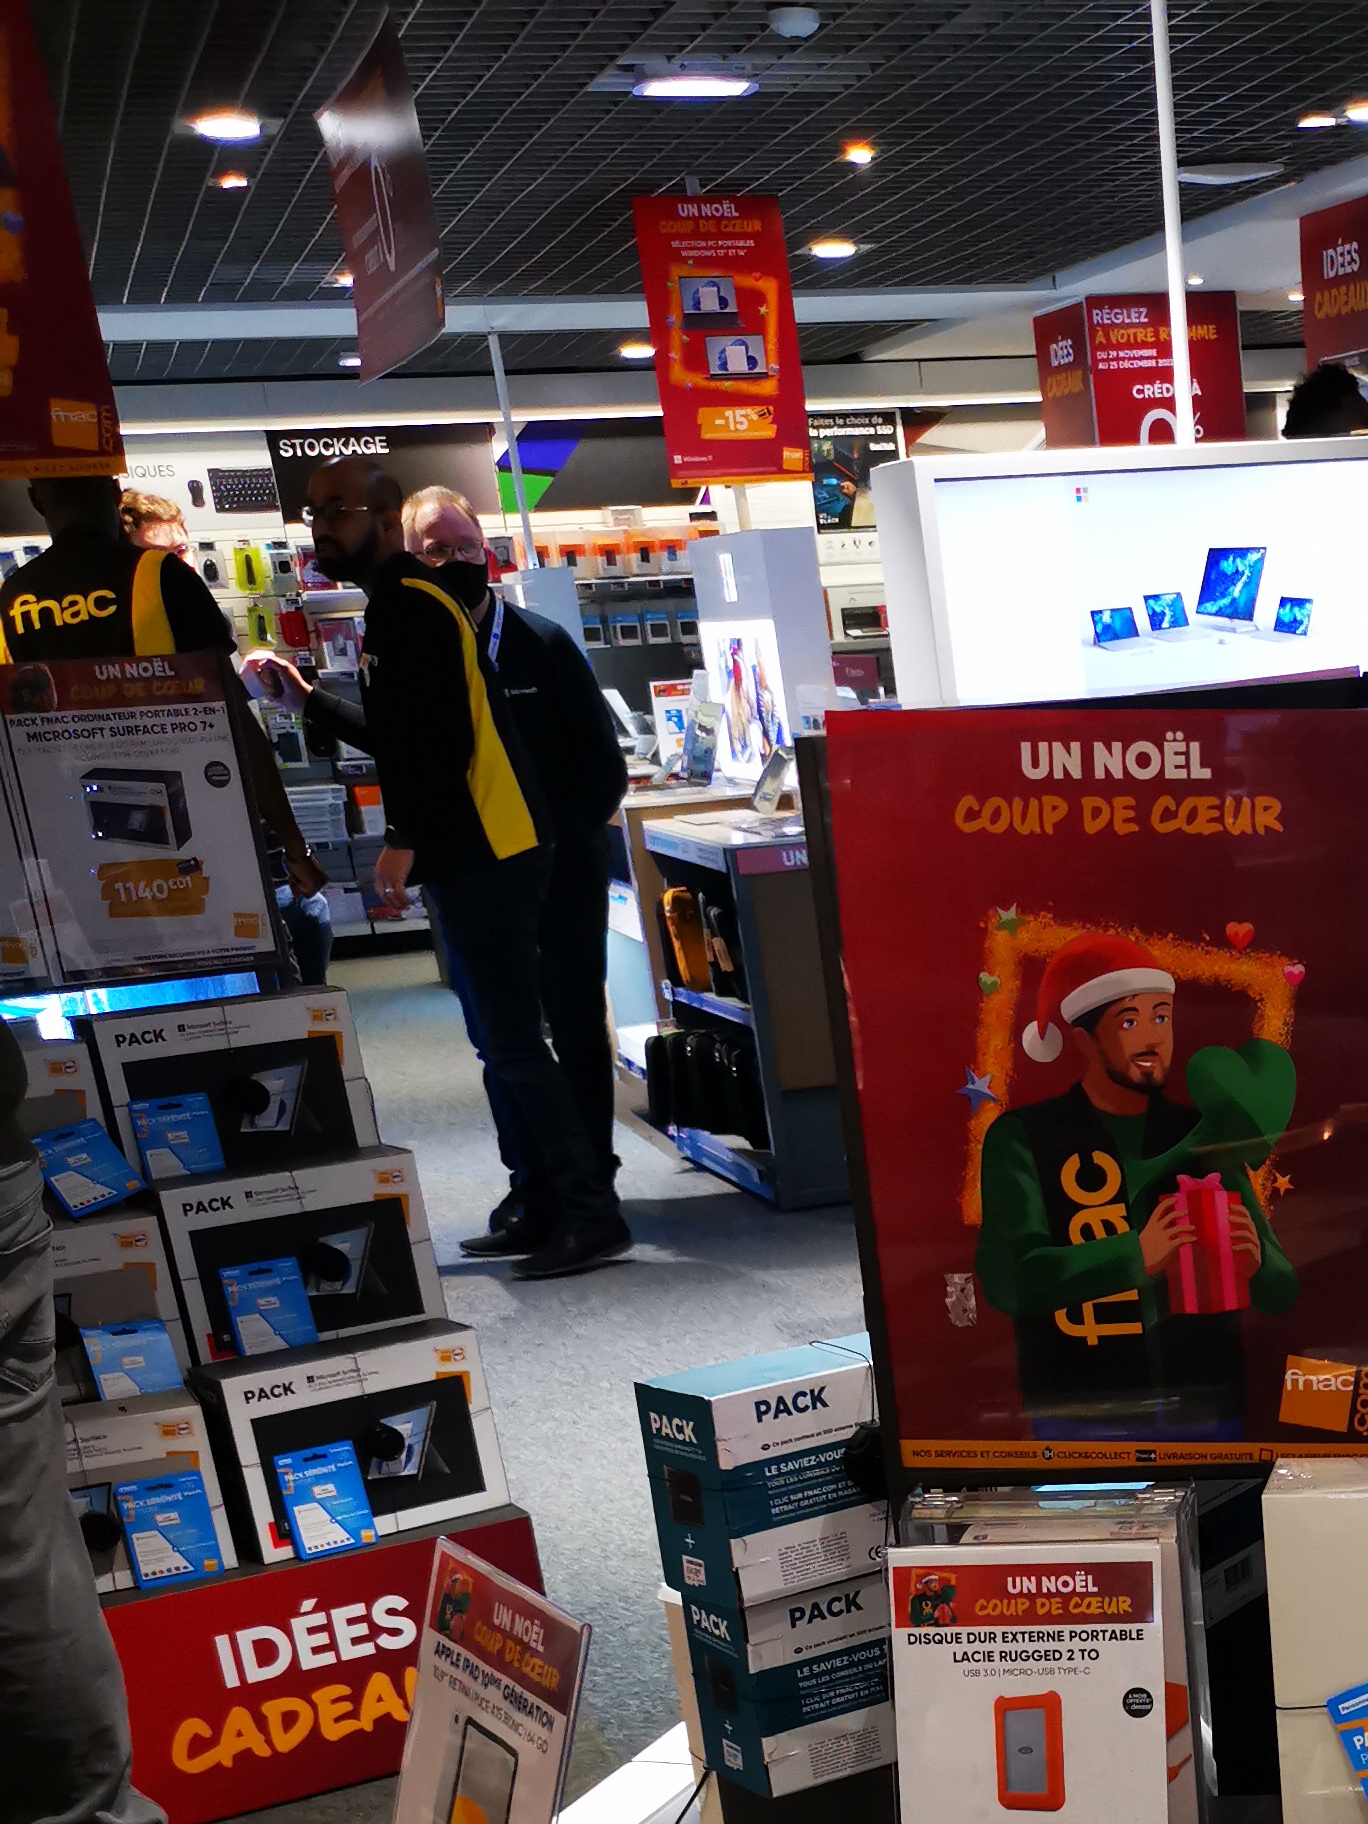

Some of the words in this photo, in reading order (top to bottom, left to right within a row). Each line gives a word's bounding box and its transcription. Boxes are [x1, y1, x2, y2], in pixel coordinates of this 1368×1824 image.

[678, 204, 698, 216] UN
[701, 201, 739, 216] NOËL
[1322, 237, 1360, 279] IDÉES
[714, 409, 757, 431] -15%
[279, 436, 389, 457] STOCKAGE
[10, 589, 117, 634] fnac
[26, 729, 106, 743] MICROSOFT
[109, 723, 168, 738] SURFACE
[171, 721, 197, 733] PRO
[1021, 742, 1082, 779] UN
[1093, 731, 1211, 779] NOËL
[955, 795, 1068, 834] COUP
[1083, 796, 1140, 834] DE
[1151, 795, 1284, 834] CŒUR
[114, 1026, 167, 1050] PACK
[180, 1196, 233, 1217] PACK
[1286, 1370, 1354, 1392] fnac
[243, 1380, 296, 1405] PACK
[754, 1386, 830, 1424] PACK
[912, 1450, 930, 1459] NOS
[932, 1449, 978, 1459] SERVICES
[980, 1449, 991, 1458] ET
[994, 1449, 1038, 1459] CONSEILS
[1057, 1450, 1131, 1460] CLICK&COLLECT
[1158, 1451, 1207, 1461] LIVRAISON
[1210, 1451, 1254, 1461] GRATUITE
[1007, 1576, 1036, 1593] UN
[1042, 1571, 1098, 1593] NOËL
[789, 1590, 864, 1629] PACK
[975, 1599, 1030, 1615] COUP
[1035, 1598, 1063, 1615] DE
[1069, 1596, 1132, 1614] CŒUR
[492, 1602, 513, 1631] UN
[513, 1614, 545, 1653] NOËL
[907, 1633, 963, 1645] DISQUE
[967, 1632, 997, 1643] DUR
[1001, 1630, 1065, 1644] EXTERNE
[1069, 1629, 1144, 1641] PORTABLE
[213, 1594, 418, 1689] IDÉES
[953, 1651, 995, 1663] LACIE
[999, 1649, 1063, 1662] RUGGED
[1066, 1649, 1075, 1661] 2
[1079, 1649, 1100, 1661] TO
[963, 1669, 980, 1677] USB
[983, 1668, 997, 1676] 3.0
[1003, 1667, 1055, 1676] MICRO-USB
[1057, 1666, 1091, 1675] TYPE-C
